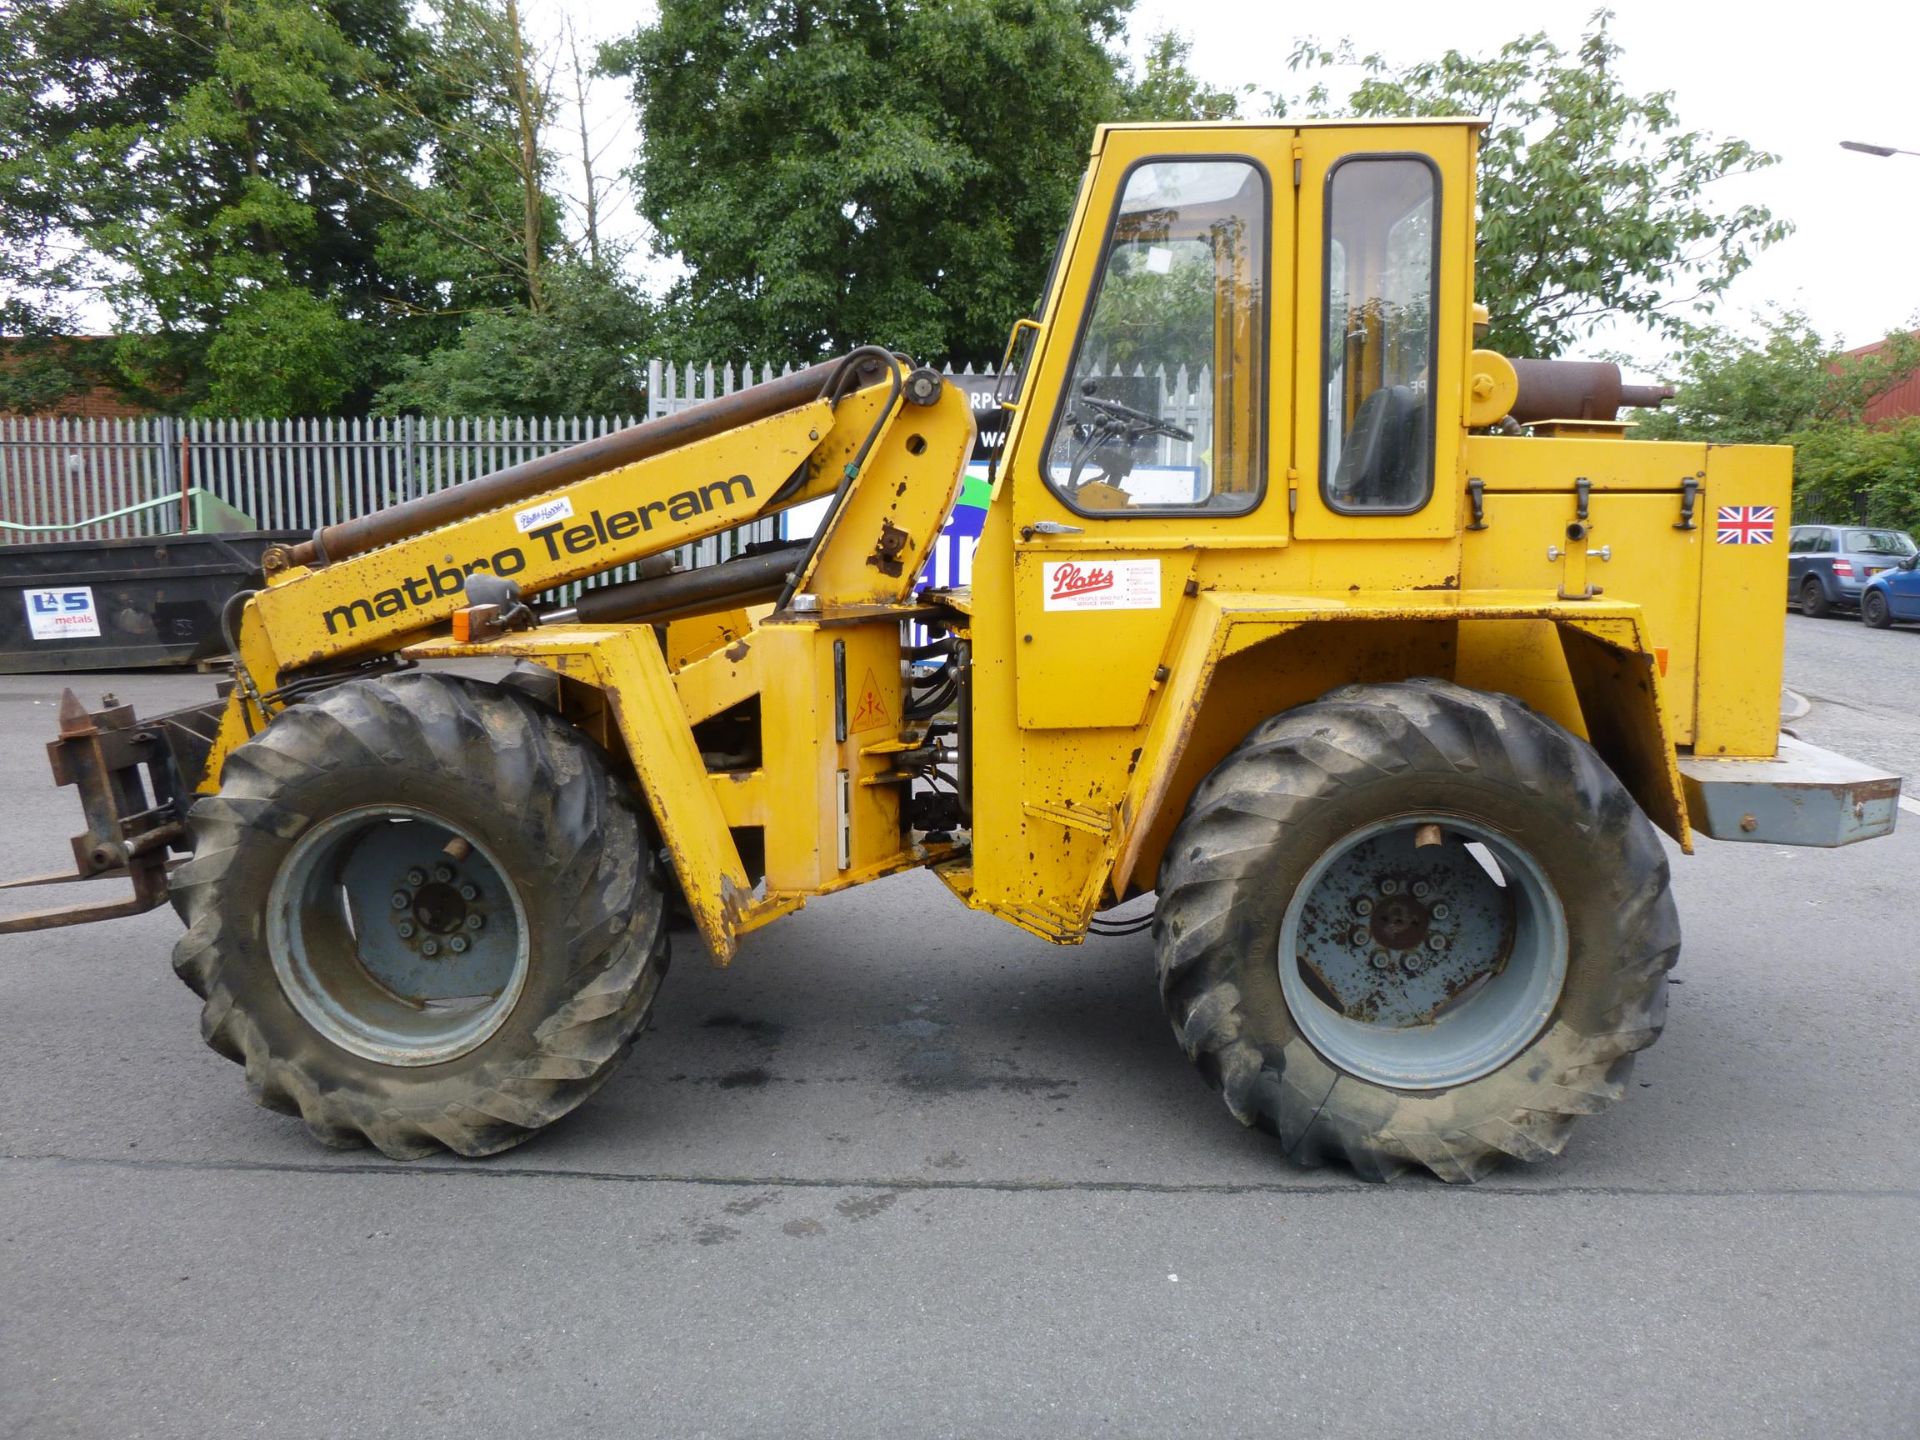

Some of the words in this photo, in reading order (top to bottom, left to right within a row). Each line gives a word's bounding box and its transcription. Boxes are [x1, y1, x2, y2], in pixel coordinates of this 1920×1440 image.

[322, 547, 526, 635] matbro
[529, 474, 757, 562] Teleram
[1053, 562, 1114, 593] Platts
[55, 614, 93, 625] metals
